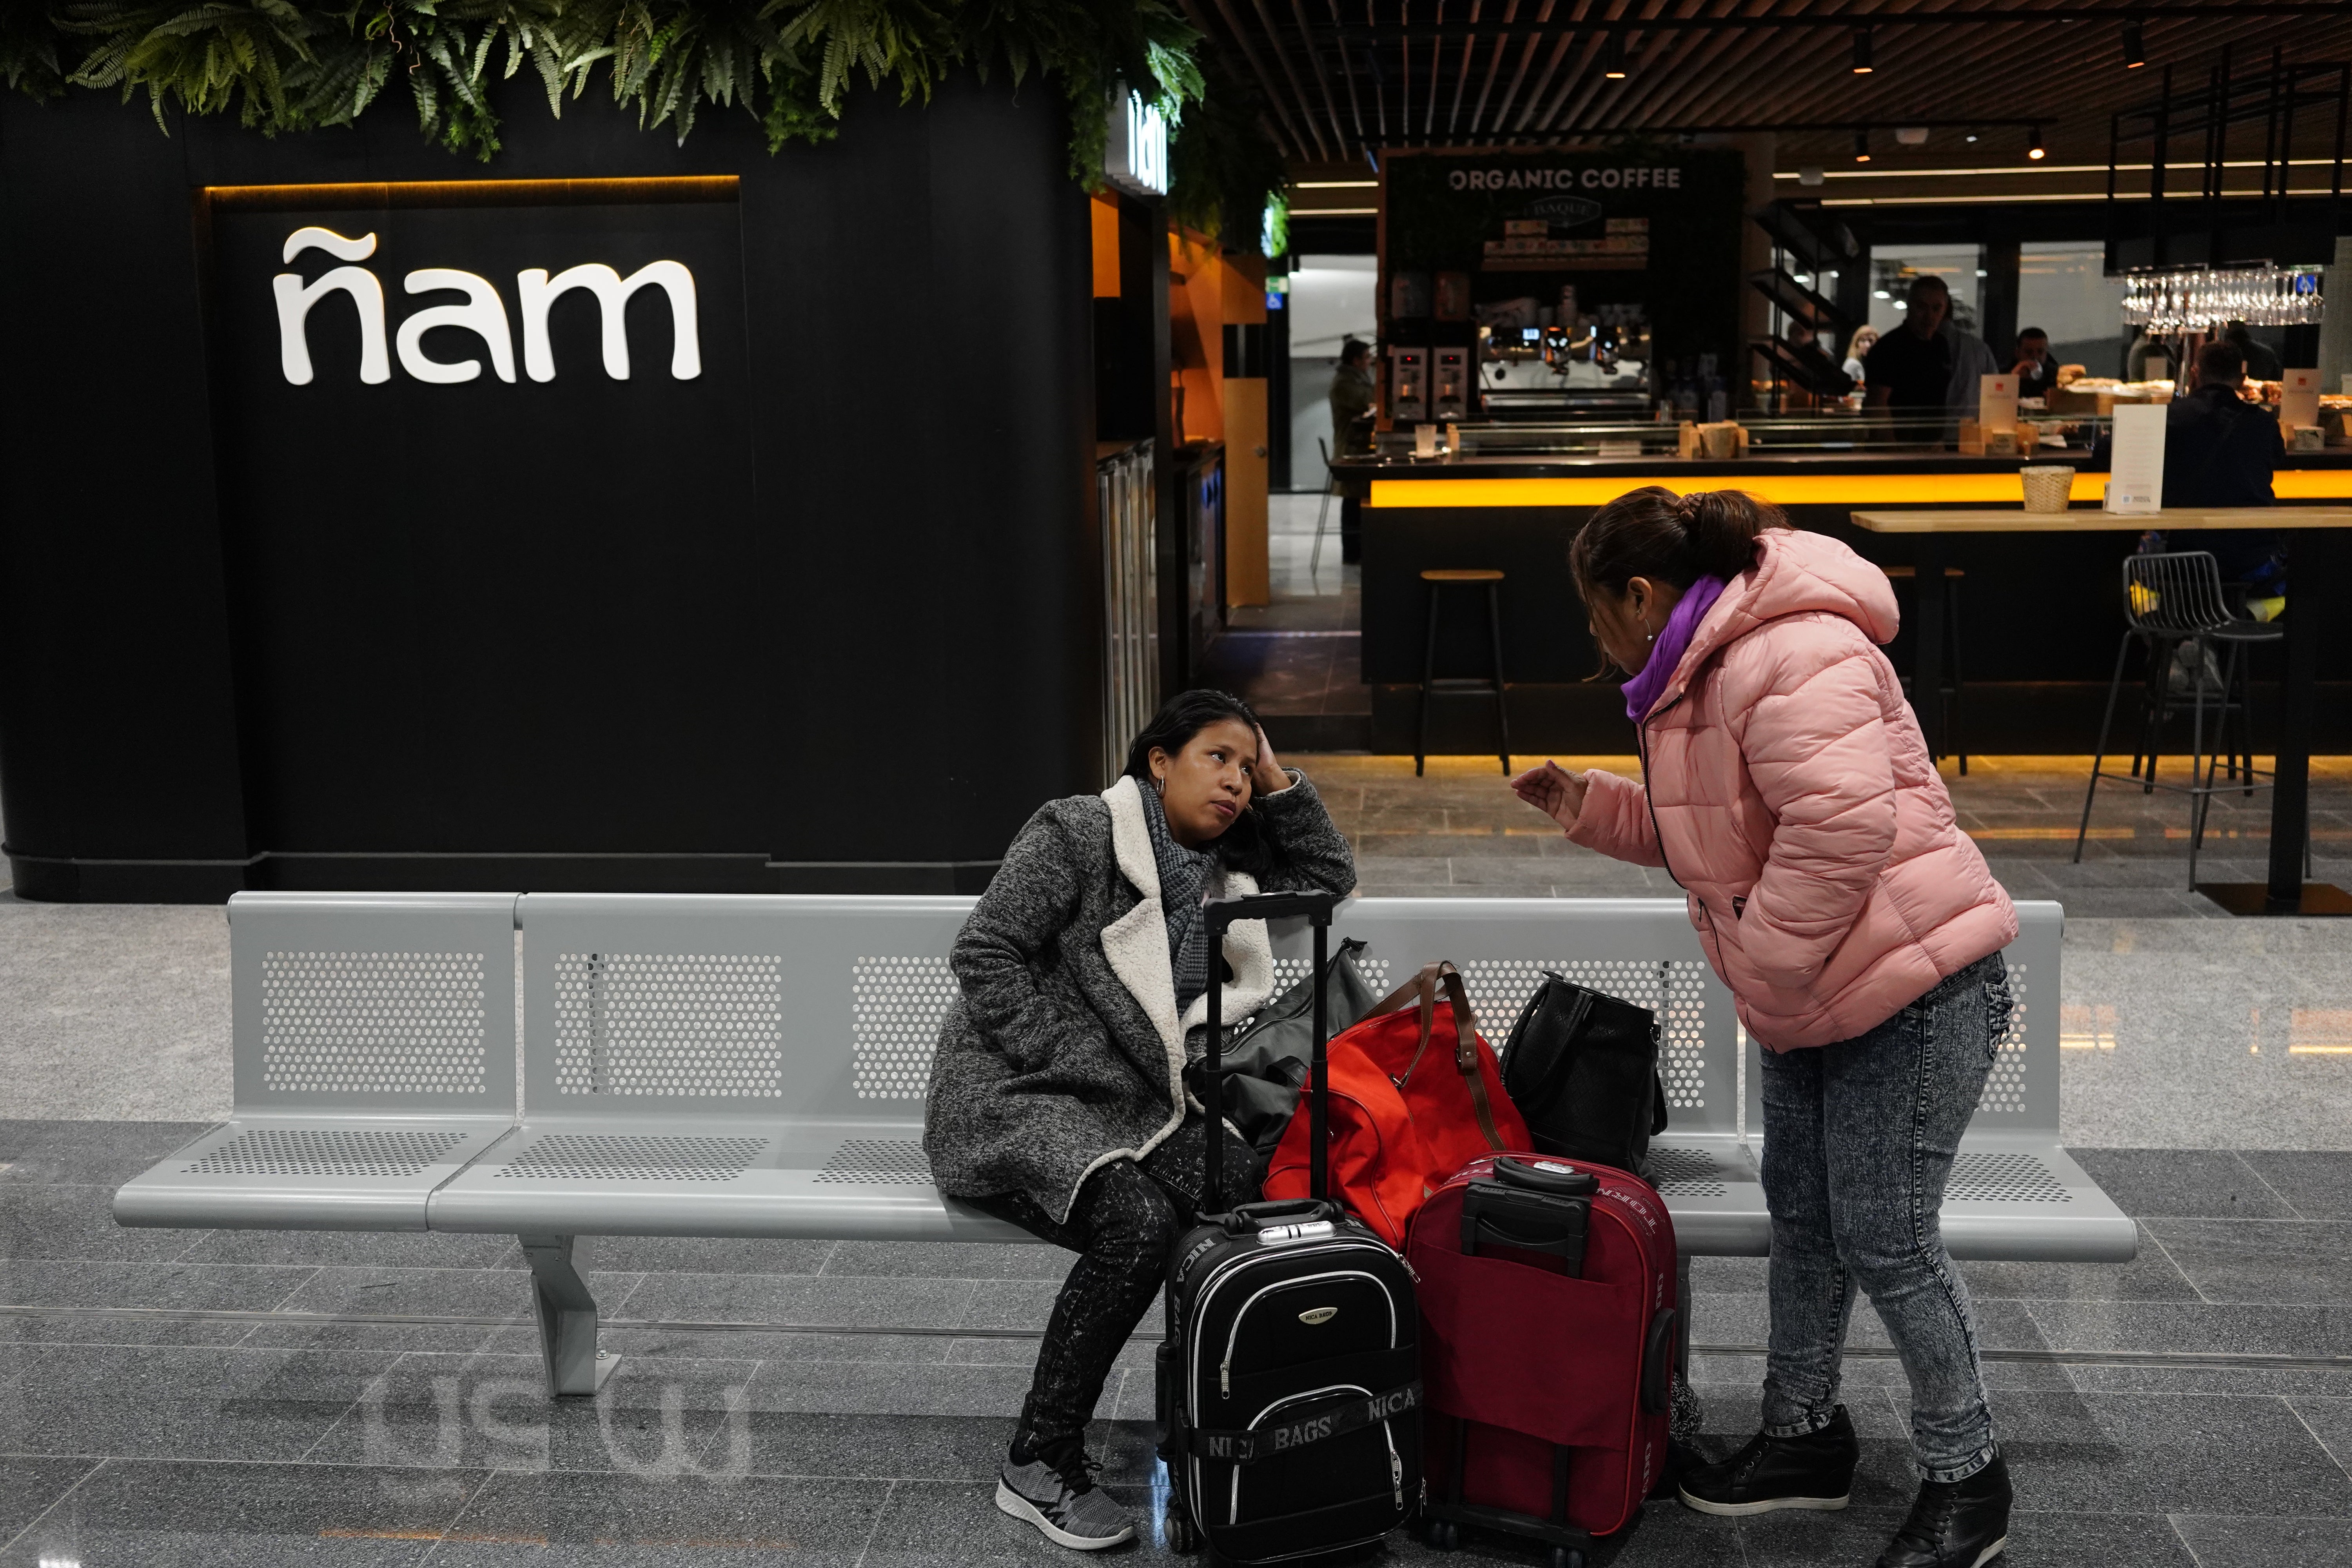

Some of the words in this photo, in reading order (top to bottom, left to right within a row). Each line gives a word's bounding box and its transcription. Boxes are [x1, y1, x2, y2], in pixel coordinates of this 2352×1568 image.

[1449, 169, 1573, 190] ORGANIC
[1581, 169, 1681, 189] COFFEE
[273, 227, 701, 385] ñam
[1176, 1237, 1216, 1283] NICA
[1275, 1416, 1332, 1450] BAGS
[1367, 1388, 1416, 1422] NICA
